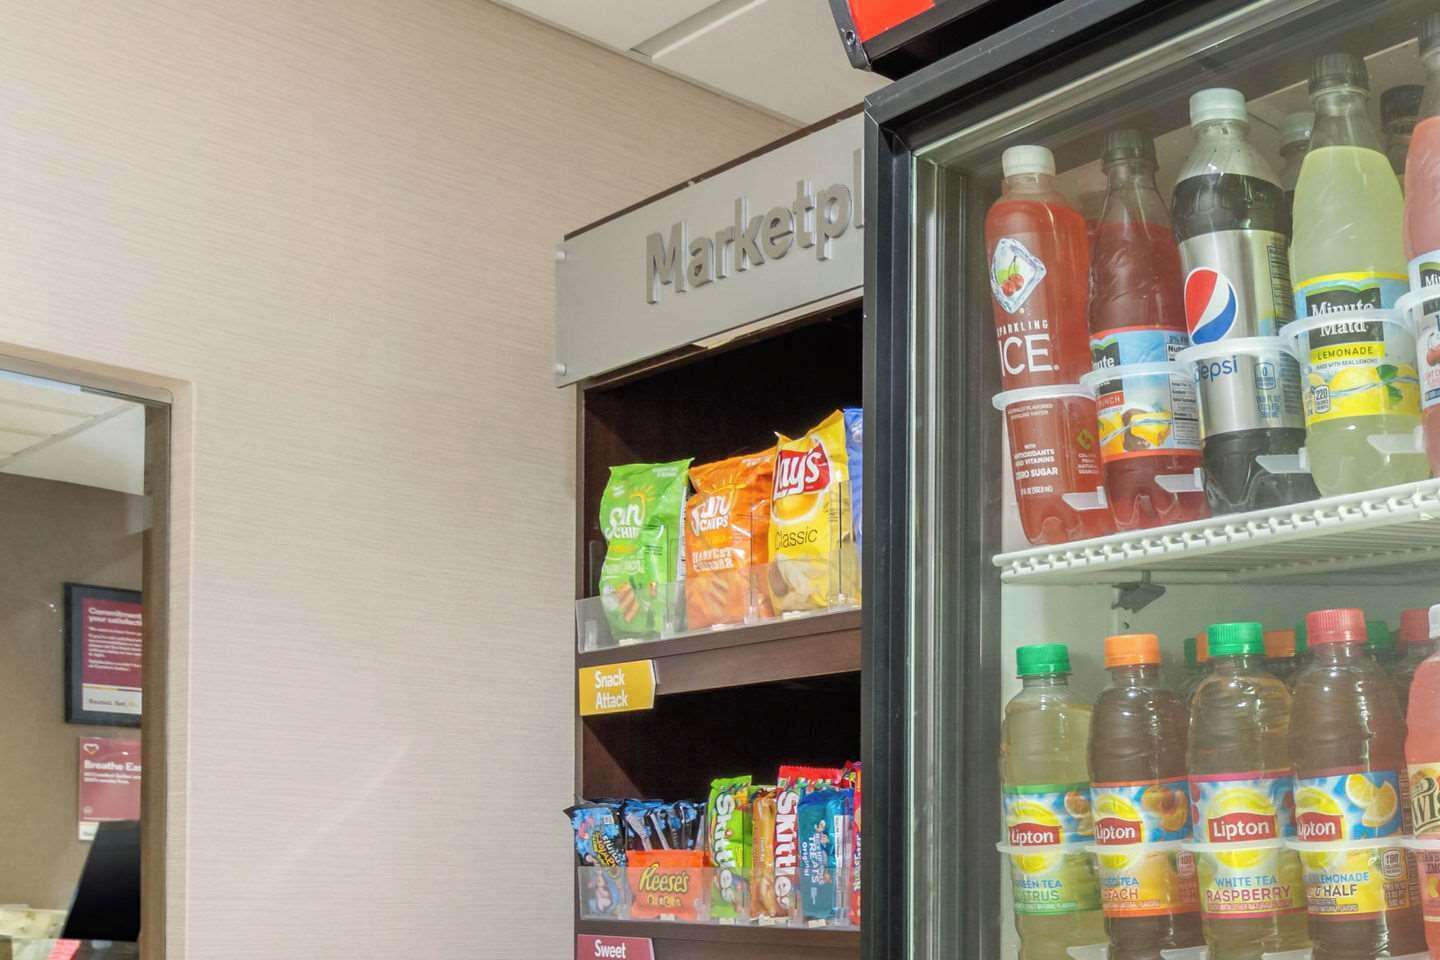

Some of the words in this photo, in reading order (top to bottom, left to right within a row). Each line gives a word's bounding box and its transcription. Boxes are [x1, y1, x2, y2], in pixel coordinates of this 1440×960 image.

[1317, 346, 1374, 361] LEMONADE
[1030, 467, 1059, 478] SUGAR
[594, 668, 625, 689] Snack
[595, 689, 629, 710] Attack
[84, 759, 124, 771] Breathe
[1011, 829, 1055, 847] Lipton
[1213, 821, 1270, 840] Lipton
[714, 792, 737, 902] Skittles
[639, 863, 690, 893] Reese's
[1043, 879, 1063, 889] TEA
[1120, 877, 1139, 886] TEA
[1215, 875, 1253, 887] WHITE
[1256, 875, 1277, 886] TEA
[1206, 885, 1291, 902] RASPBERRY
[1324, 884, 1358, 897] HALF
[594, 939, 627, 960] Sweet
